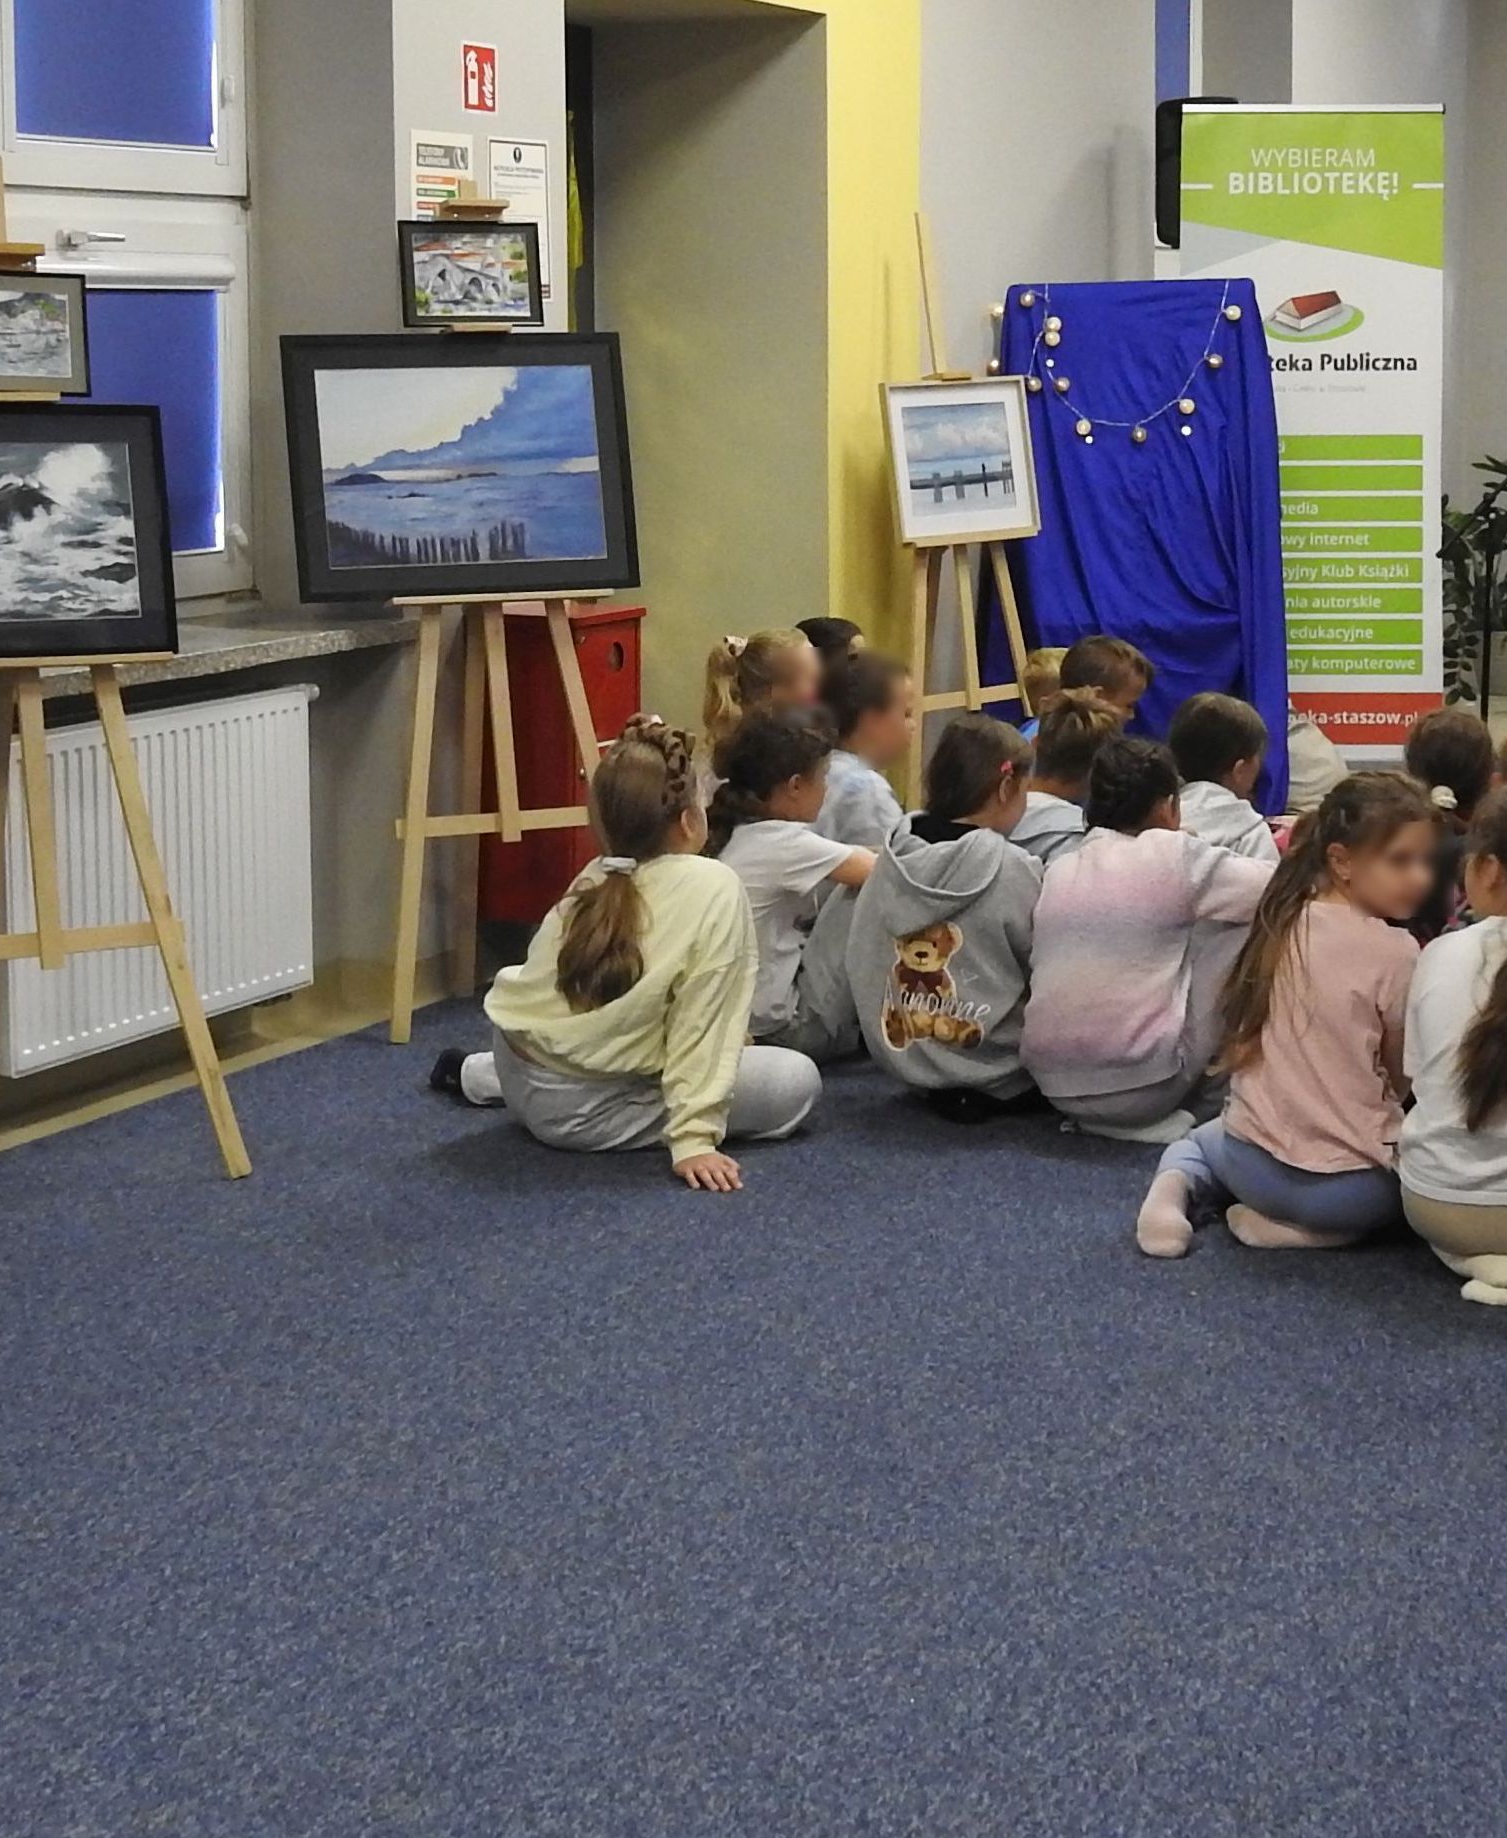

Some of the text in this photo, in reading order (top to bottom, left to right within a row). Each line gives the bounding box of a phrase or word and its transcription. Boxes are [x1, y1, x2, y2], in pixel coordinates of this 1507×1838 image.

[1251, 149, 1376, 167] WYBIERAM
[1228, 172, 1399, 200] BIBLIOTEKĘ!
[1319, 352, 1418, 372] Publiczna
[1309, 532, 1370, 546] internet
[1321, 564, 1354, 578] Klub
[1358, 564, 1409, 580] Książki
[1311, 595, 1382, 609] autorskie
[1289, 625, 1373, 642] edukacyjne
[1312, 656, 1416, 673] komputerowe
